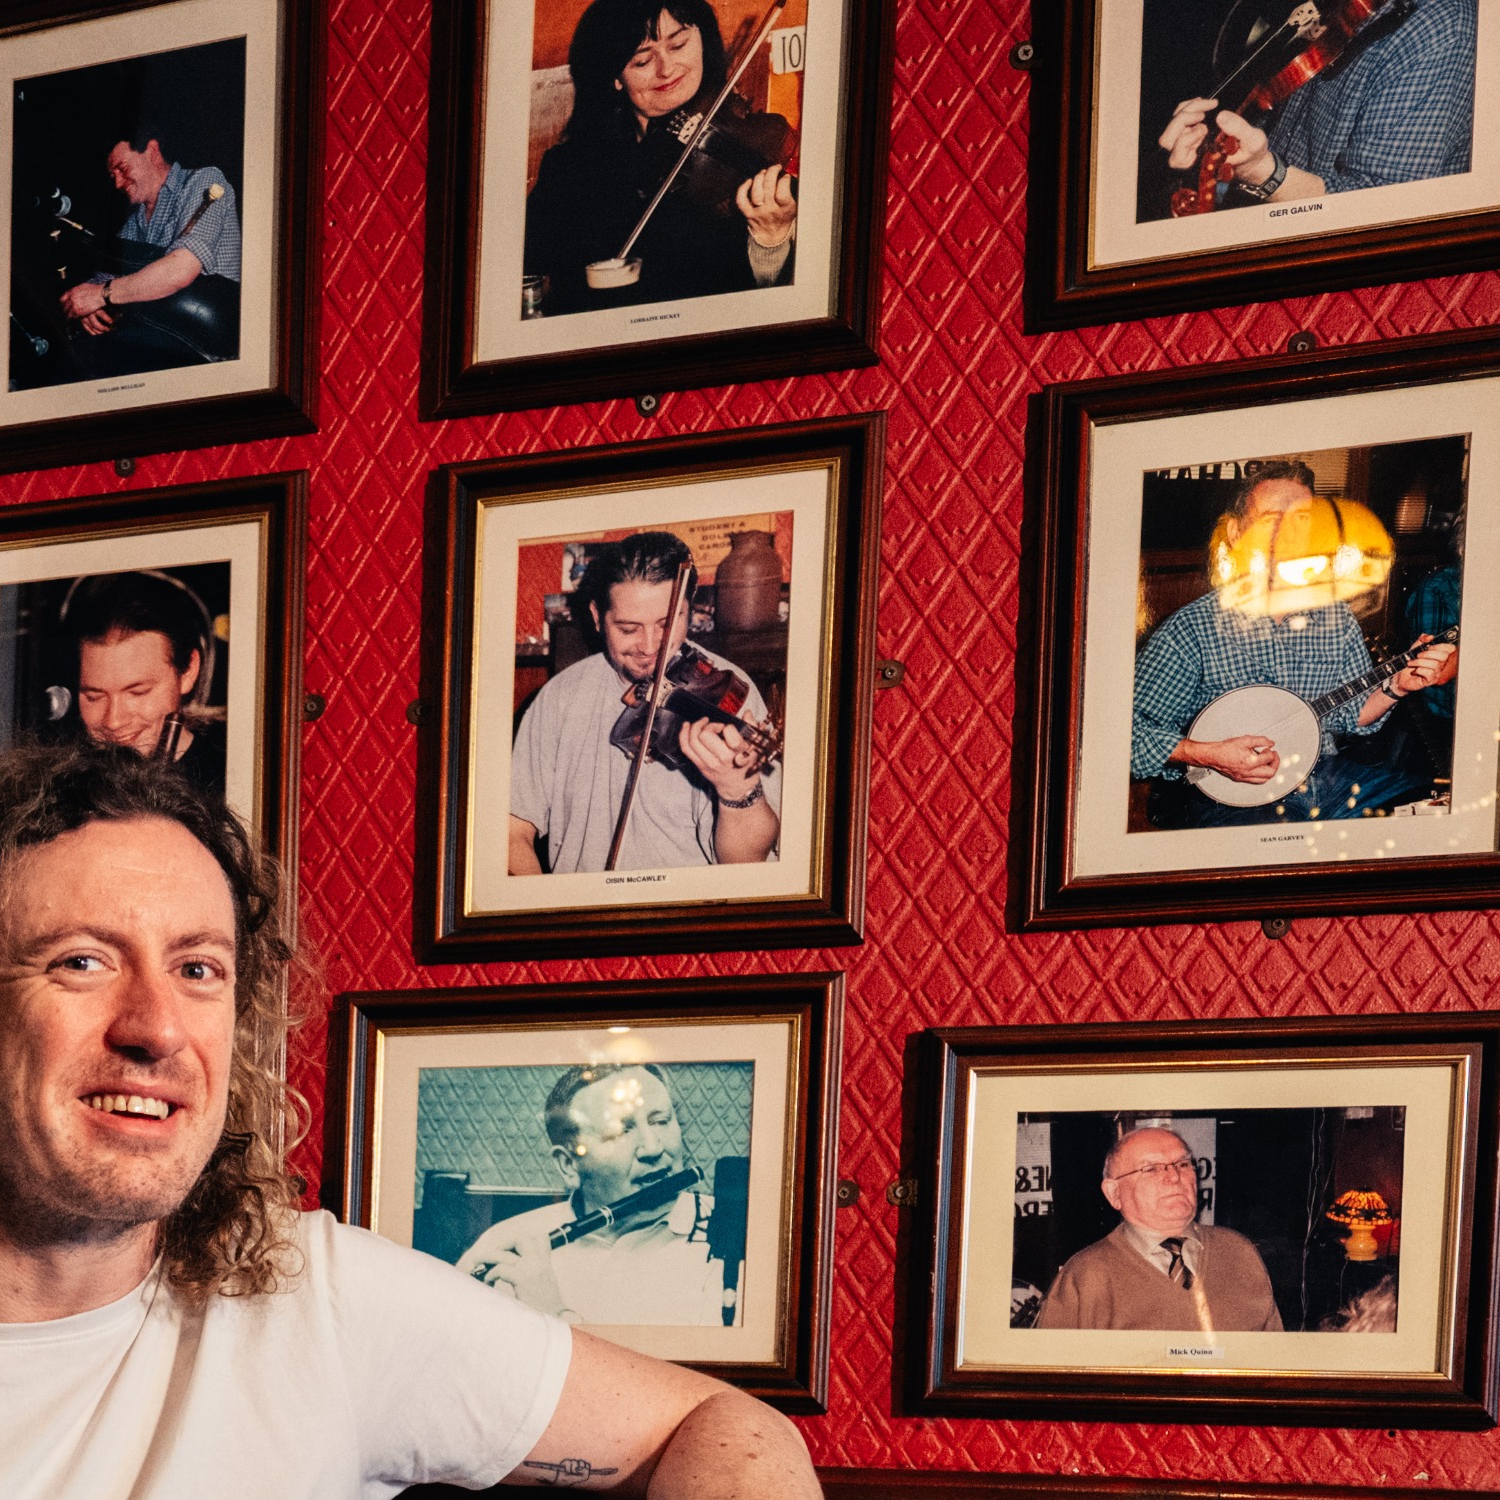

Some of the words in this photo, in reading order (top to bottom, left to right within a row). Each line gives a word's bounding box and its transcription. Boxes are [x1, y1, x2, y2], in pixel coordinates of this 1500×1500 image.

[781, 34, 802, 74] 10
[1269, 209, 1288, 218] GER
[1290, 203, 1323, 214] GALVIN
[626, 874, 667, 883] McCAWLEY
[1190, 1348, 1213, 1356] Quinn
